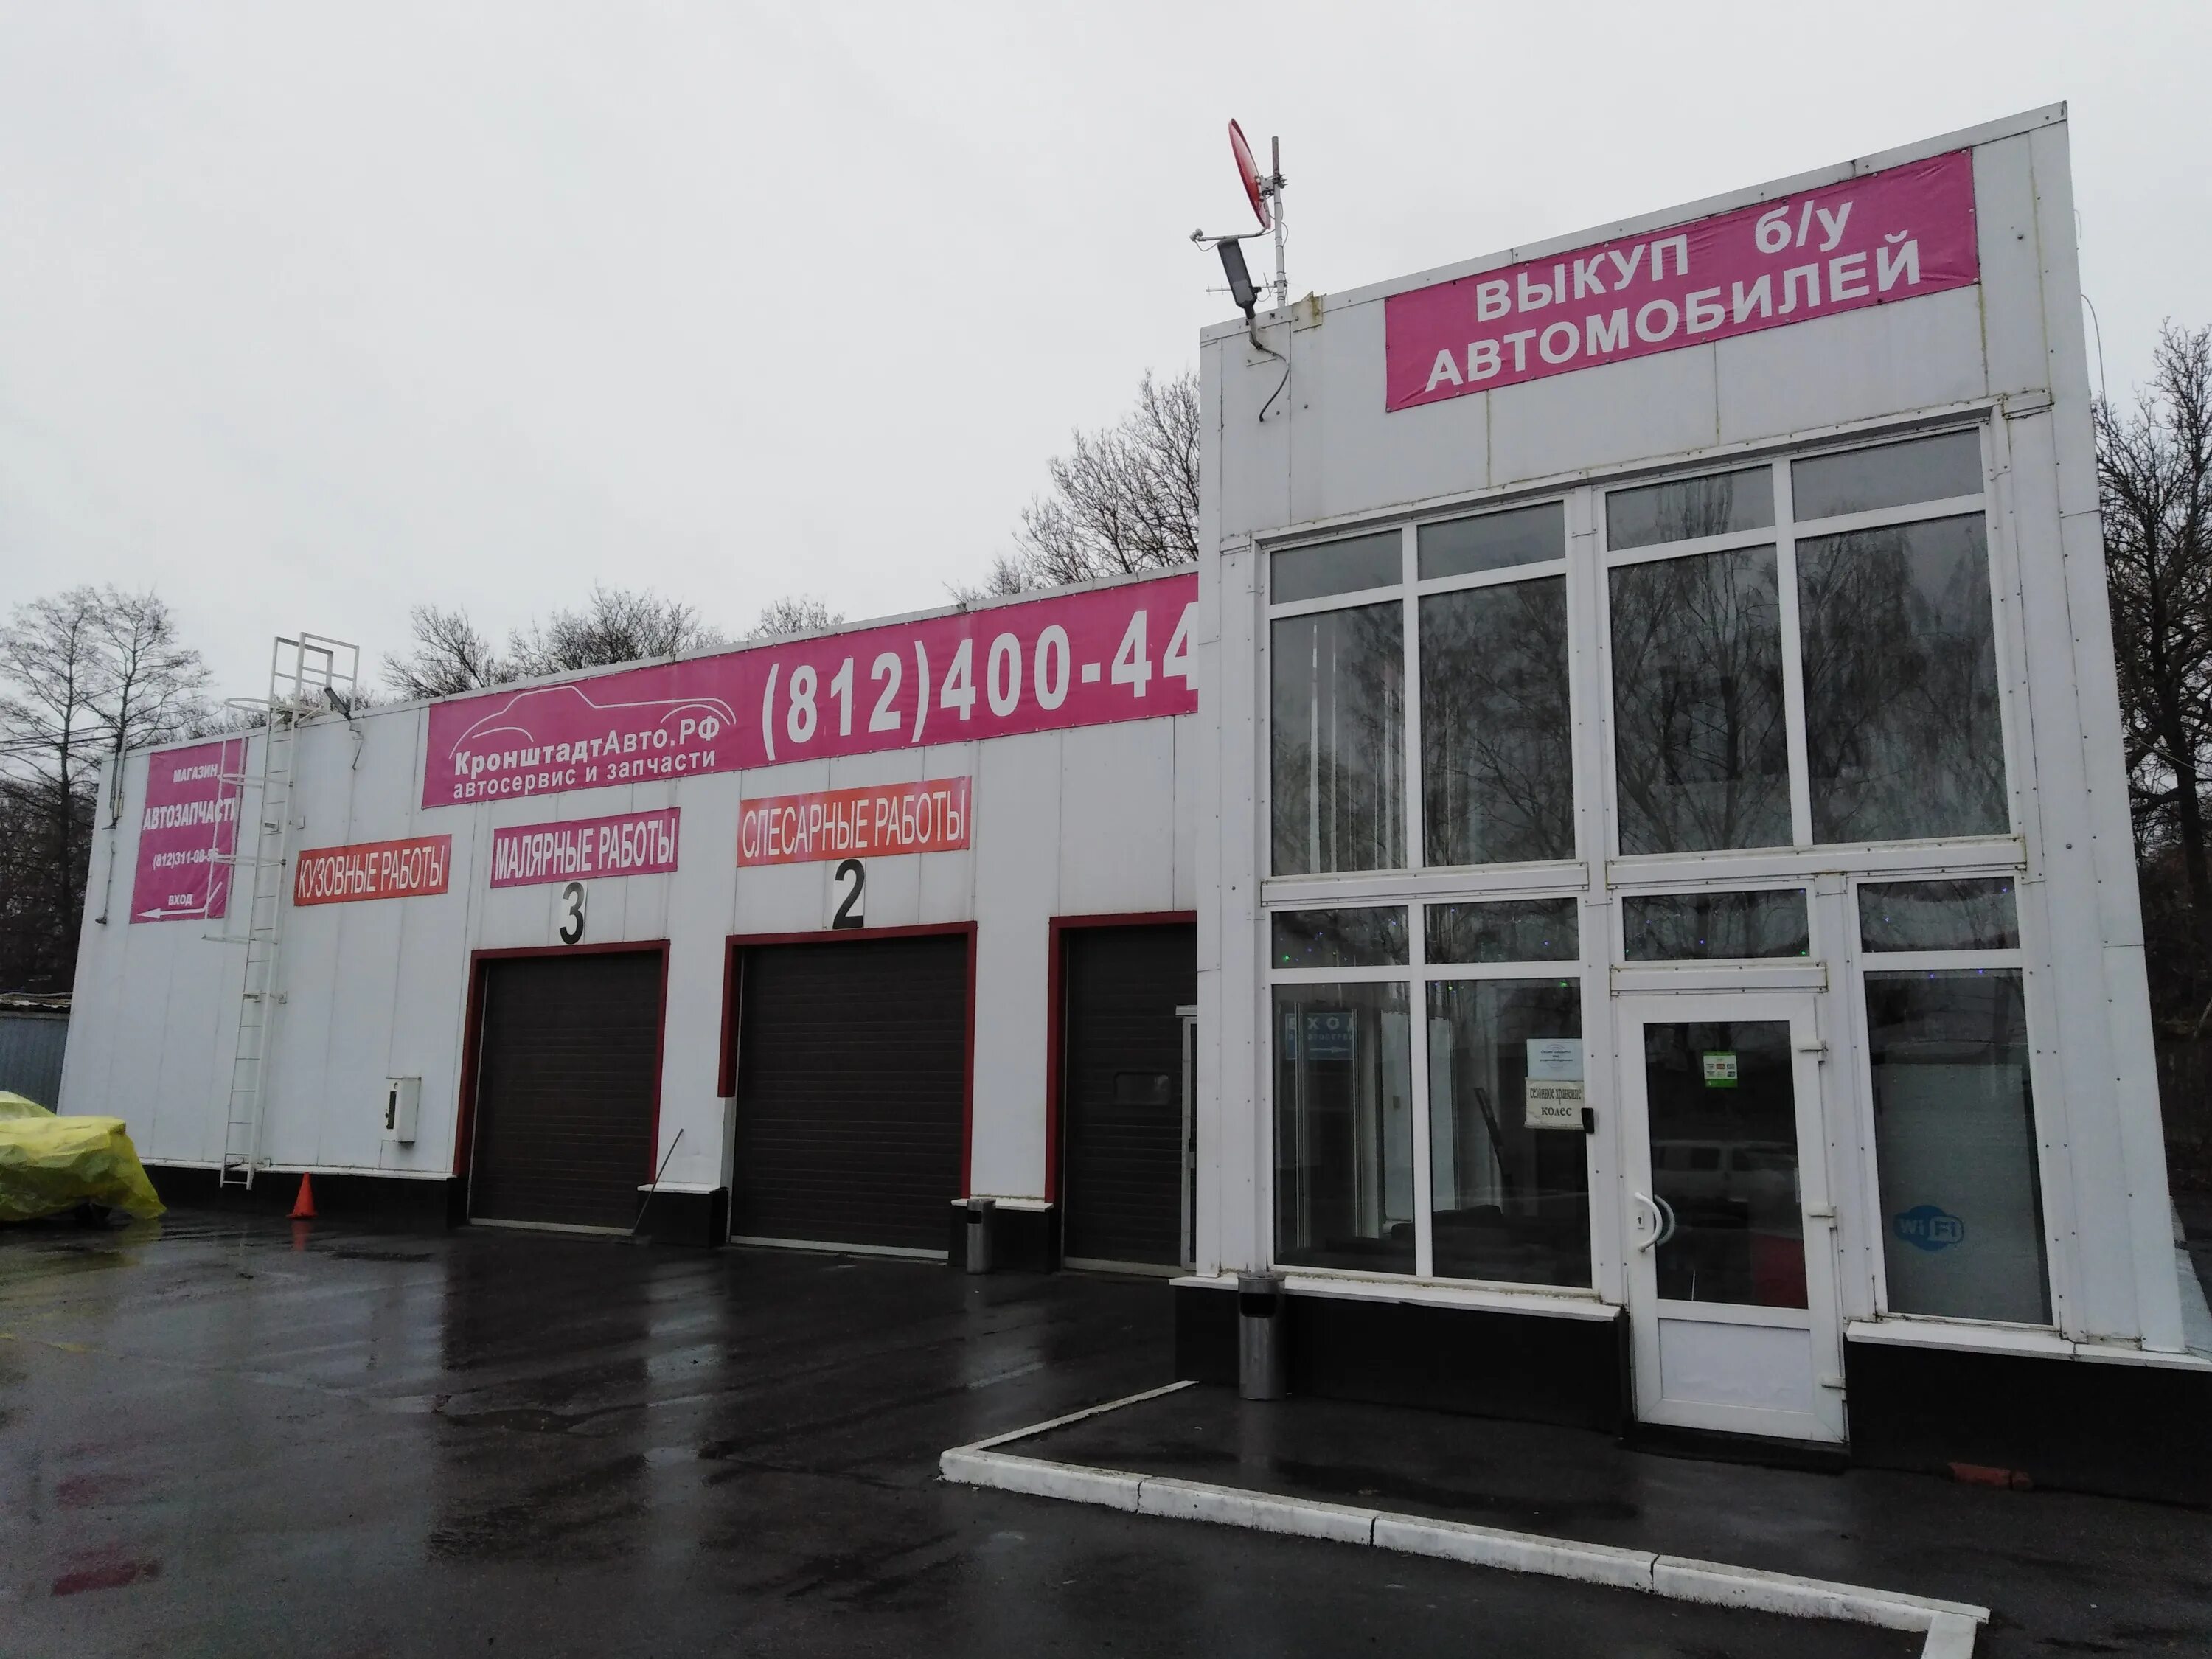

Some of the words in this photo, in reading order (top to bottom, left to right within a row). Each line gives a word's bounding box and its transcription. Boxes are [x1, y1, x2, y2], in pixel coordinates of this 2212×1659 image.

[1476, 234, 1689, 323] ВЫКУП
[1755, 200, 1854, 254] б/у
[1425, 229, 1921, 392] АВТОМОБИЛЕЙ
[762, 601, 1198, 761] (812)400-44
[173, 763, 219, 783] МАГАЗИН
[453, 767, 576, 799] автосервис
[585, 765, 597, 783] и
[607, 749, 716, 779] запчасти
[454, 715, 720, 779] КронштадтАвто.РФ
[494, 827, 594, 880] МАЛЯРНЫЕ
[598, 818, 676, 870] РАБОТЫ
[742, 799, 869, 858] СЛЕСАРНЫЕ
[874, 789, 965, 846] РАБОТЫ
[168, 893, 193, 906] ВХОД
[297, 852, 379, 898] КУЗОВНЫЕ
[380, 845, 445, 891] РАБОТЫ
[832, 858, 865, 929] 2
[560, 882, 585, 945] 3
[1541, 1107, 1572, 1116] колес
